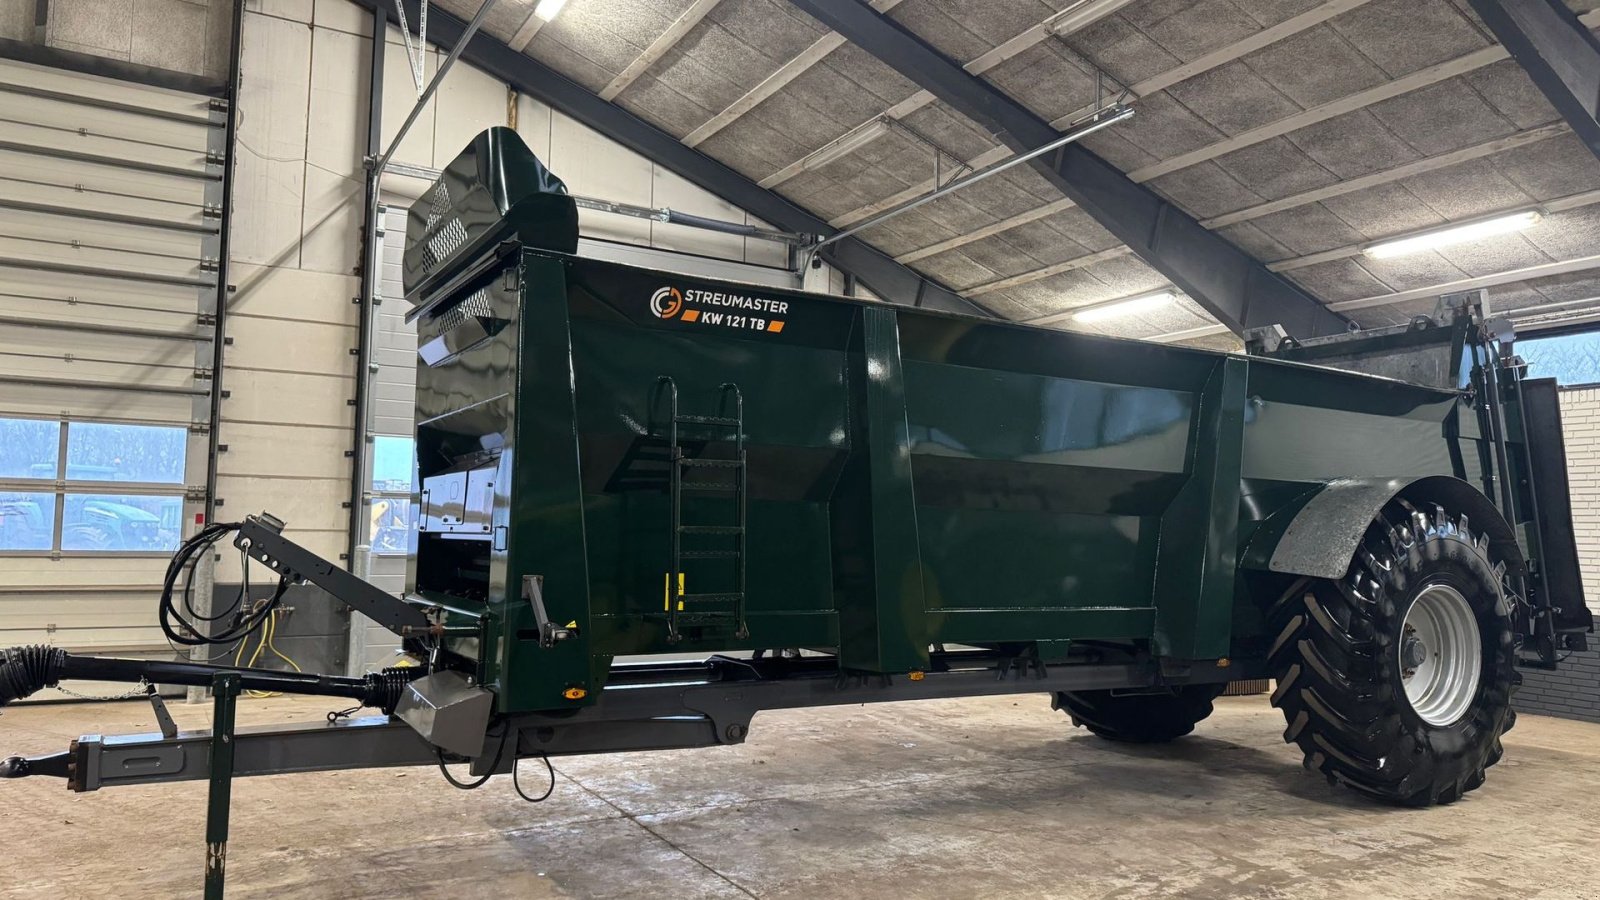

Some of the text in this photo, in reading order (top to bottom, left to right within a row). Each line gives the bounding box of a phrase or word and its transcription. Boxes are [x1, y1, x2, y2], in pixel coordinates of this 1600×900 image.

[685, 289, 789, 314] STREUMASTER
[701, 312, 765, 331] KW 121 TB
